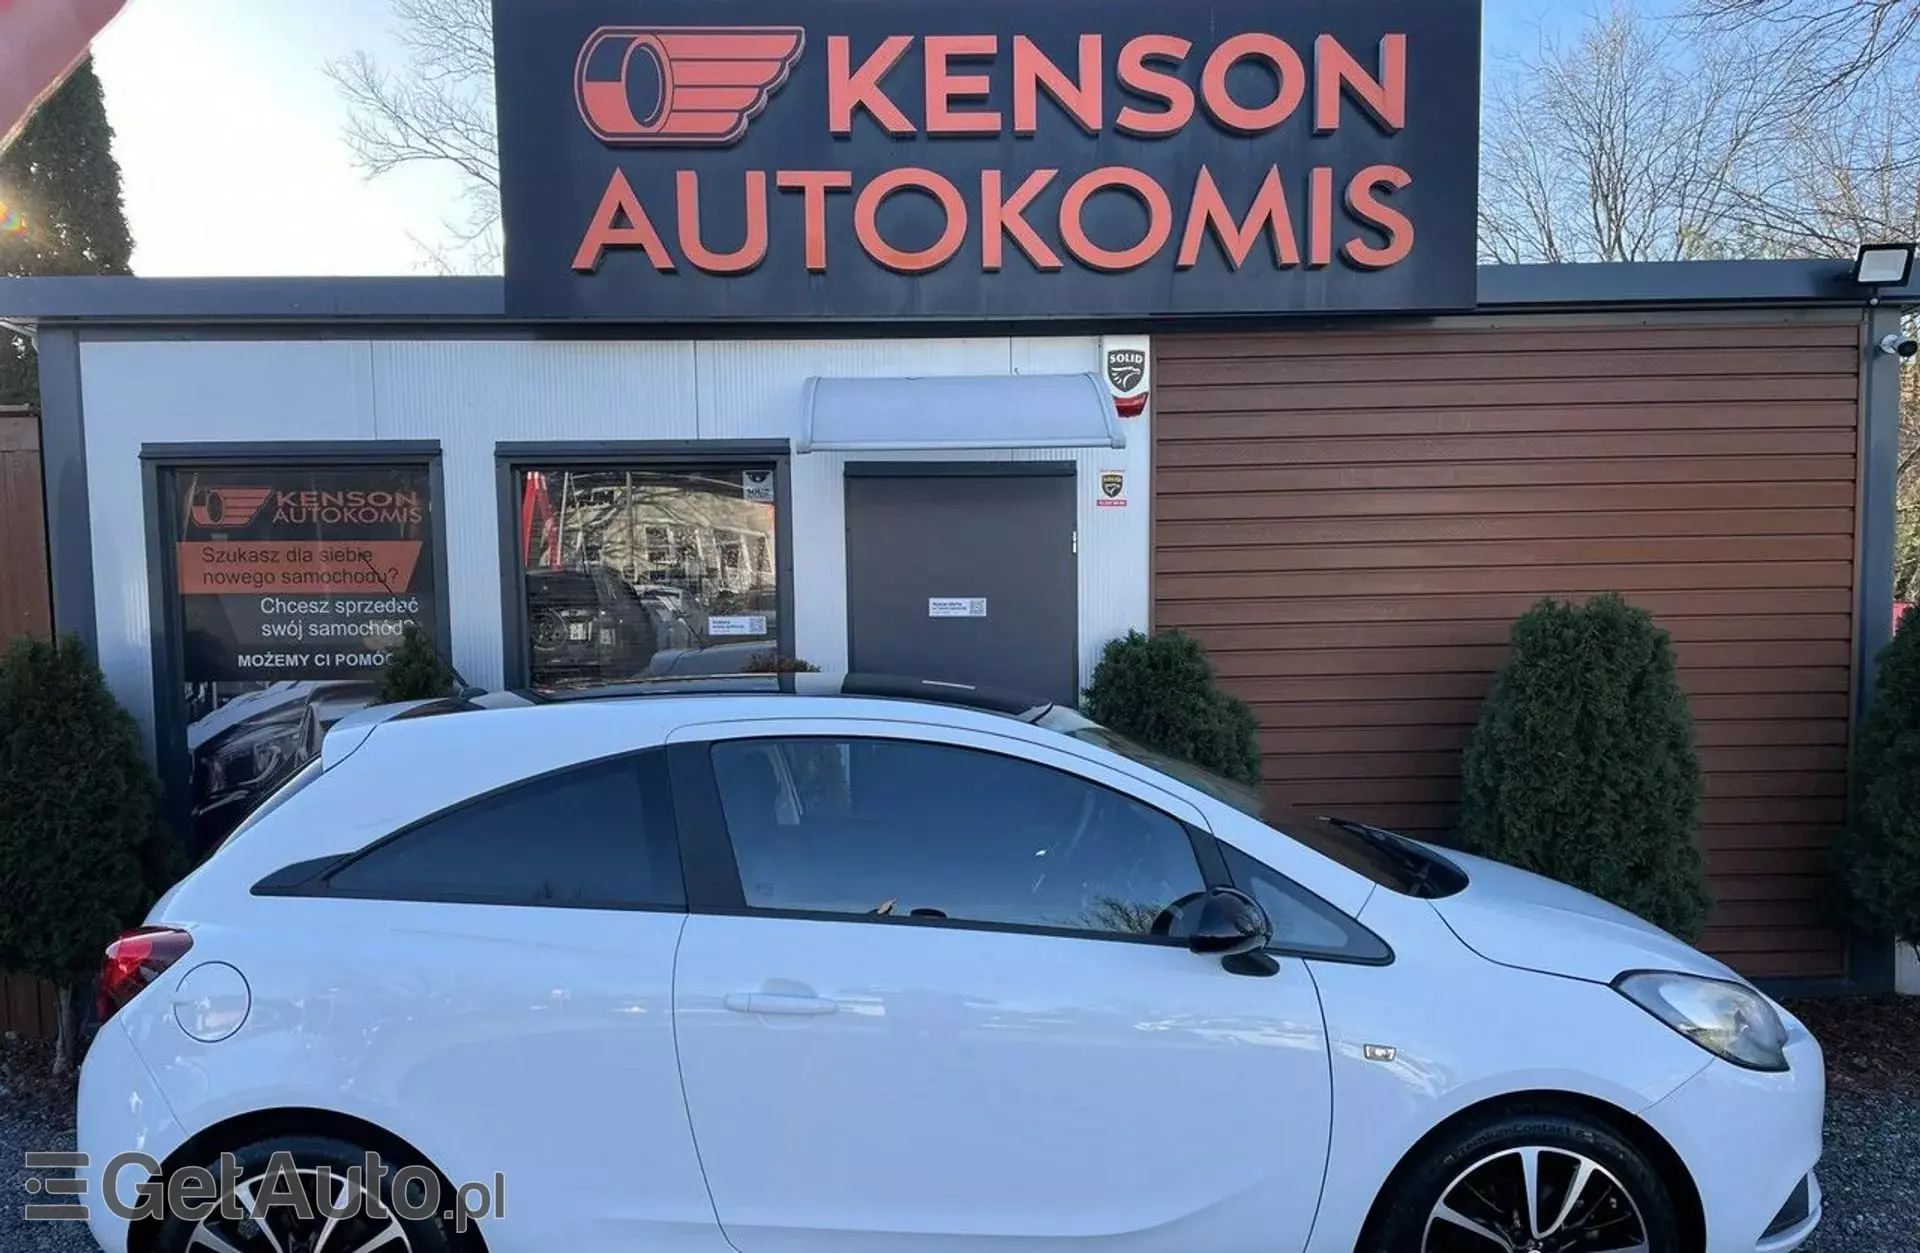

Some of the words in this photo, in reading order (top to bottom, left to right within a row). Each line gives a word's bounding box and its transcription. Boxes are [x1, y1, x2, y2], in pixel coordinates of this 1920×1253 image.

[827, 32, 1407, 137] KENSON
[571, 164, 1415, 272] AUTOKOMIS
[1110, 354, 1143, 363] SOLID
[276, 491, 418, 507] KENSON
[272, 507, 423, 524] AUTOKOMIS
[201, 546, 280, 564] Szukasz
[286, 547, 314, 563] dla
[319, 547, 373, 563] siebie
[203, 569, 276, 588] nowego
[282, 567, 399, 585] samochodu?
[260, 597, 330, 614] Chcesz
[335, 596, 419, 616] sprzedać
[261, 619, 304, 640] swój
[237, 651, 309, 668] MOŻEMY
[314, 653, 331, 667] CI
